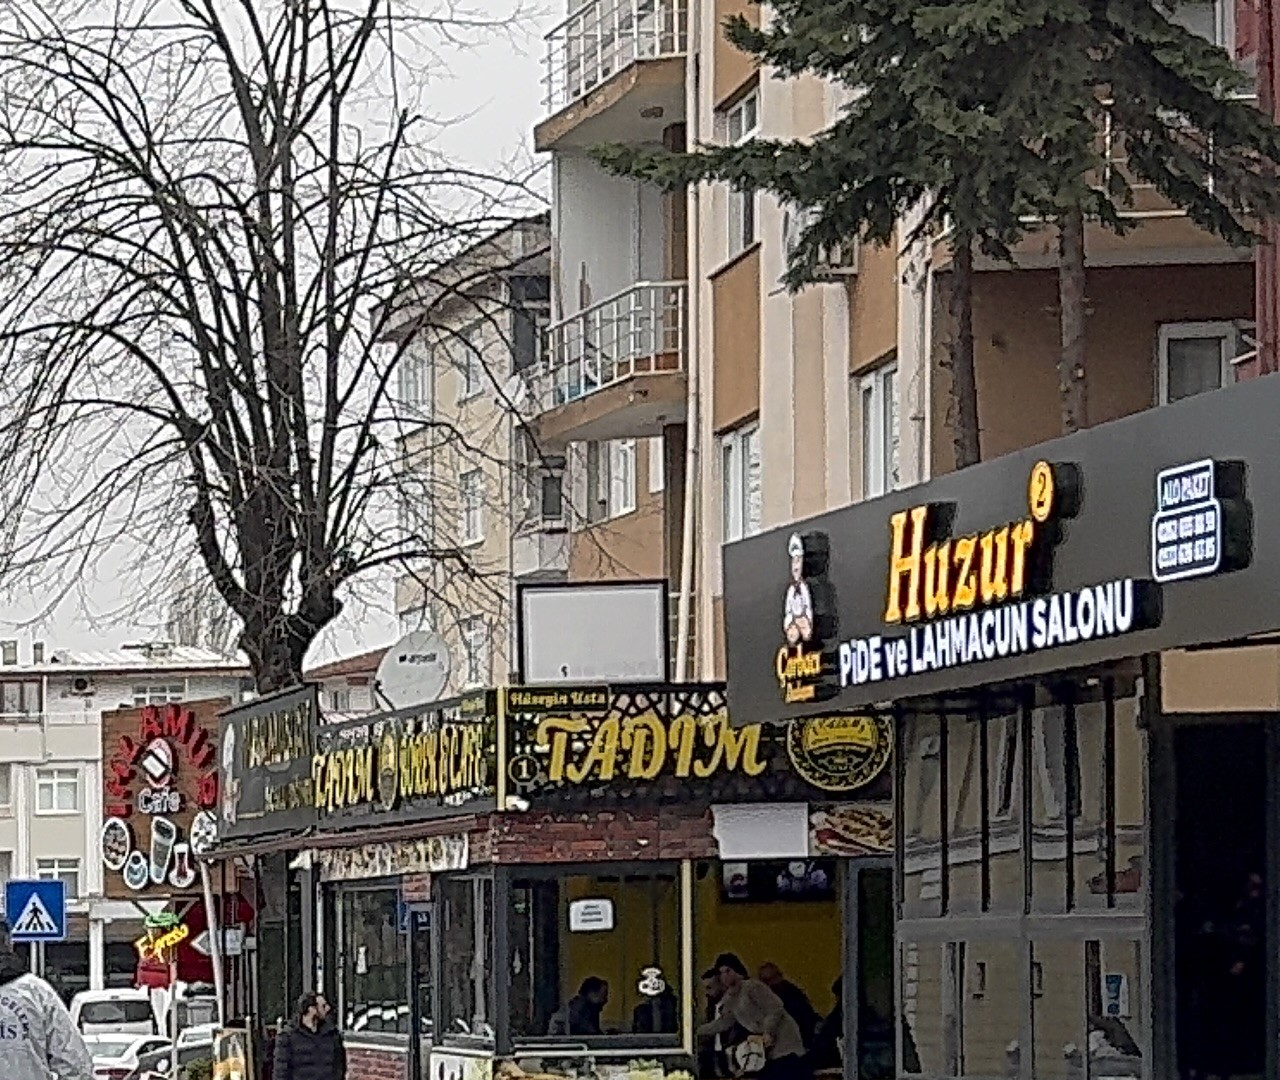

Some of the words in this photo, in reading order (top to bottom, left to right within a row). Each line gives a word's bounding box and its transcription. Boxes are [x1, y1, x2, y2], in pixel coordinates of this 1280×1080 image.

[885, 504, 1034, 625] Huzur
[840, 634, 882, 688] PİDE
[884, 639, 908, 678] ve
[910, 603, 1028, 674] LAHMACUN
[1031, 578, 1134, 651] SALONU
[538, 713, 767, 784] TADIM
